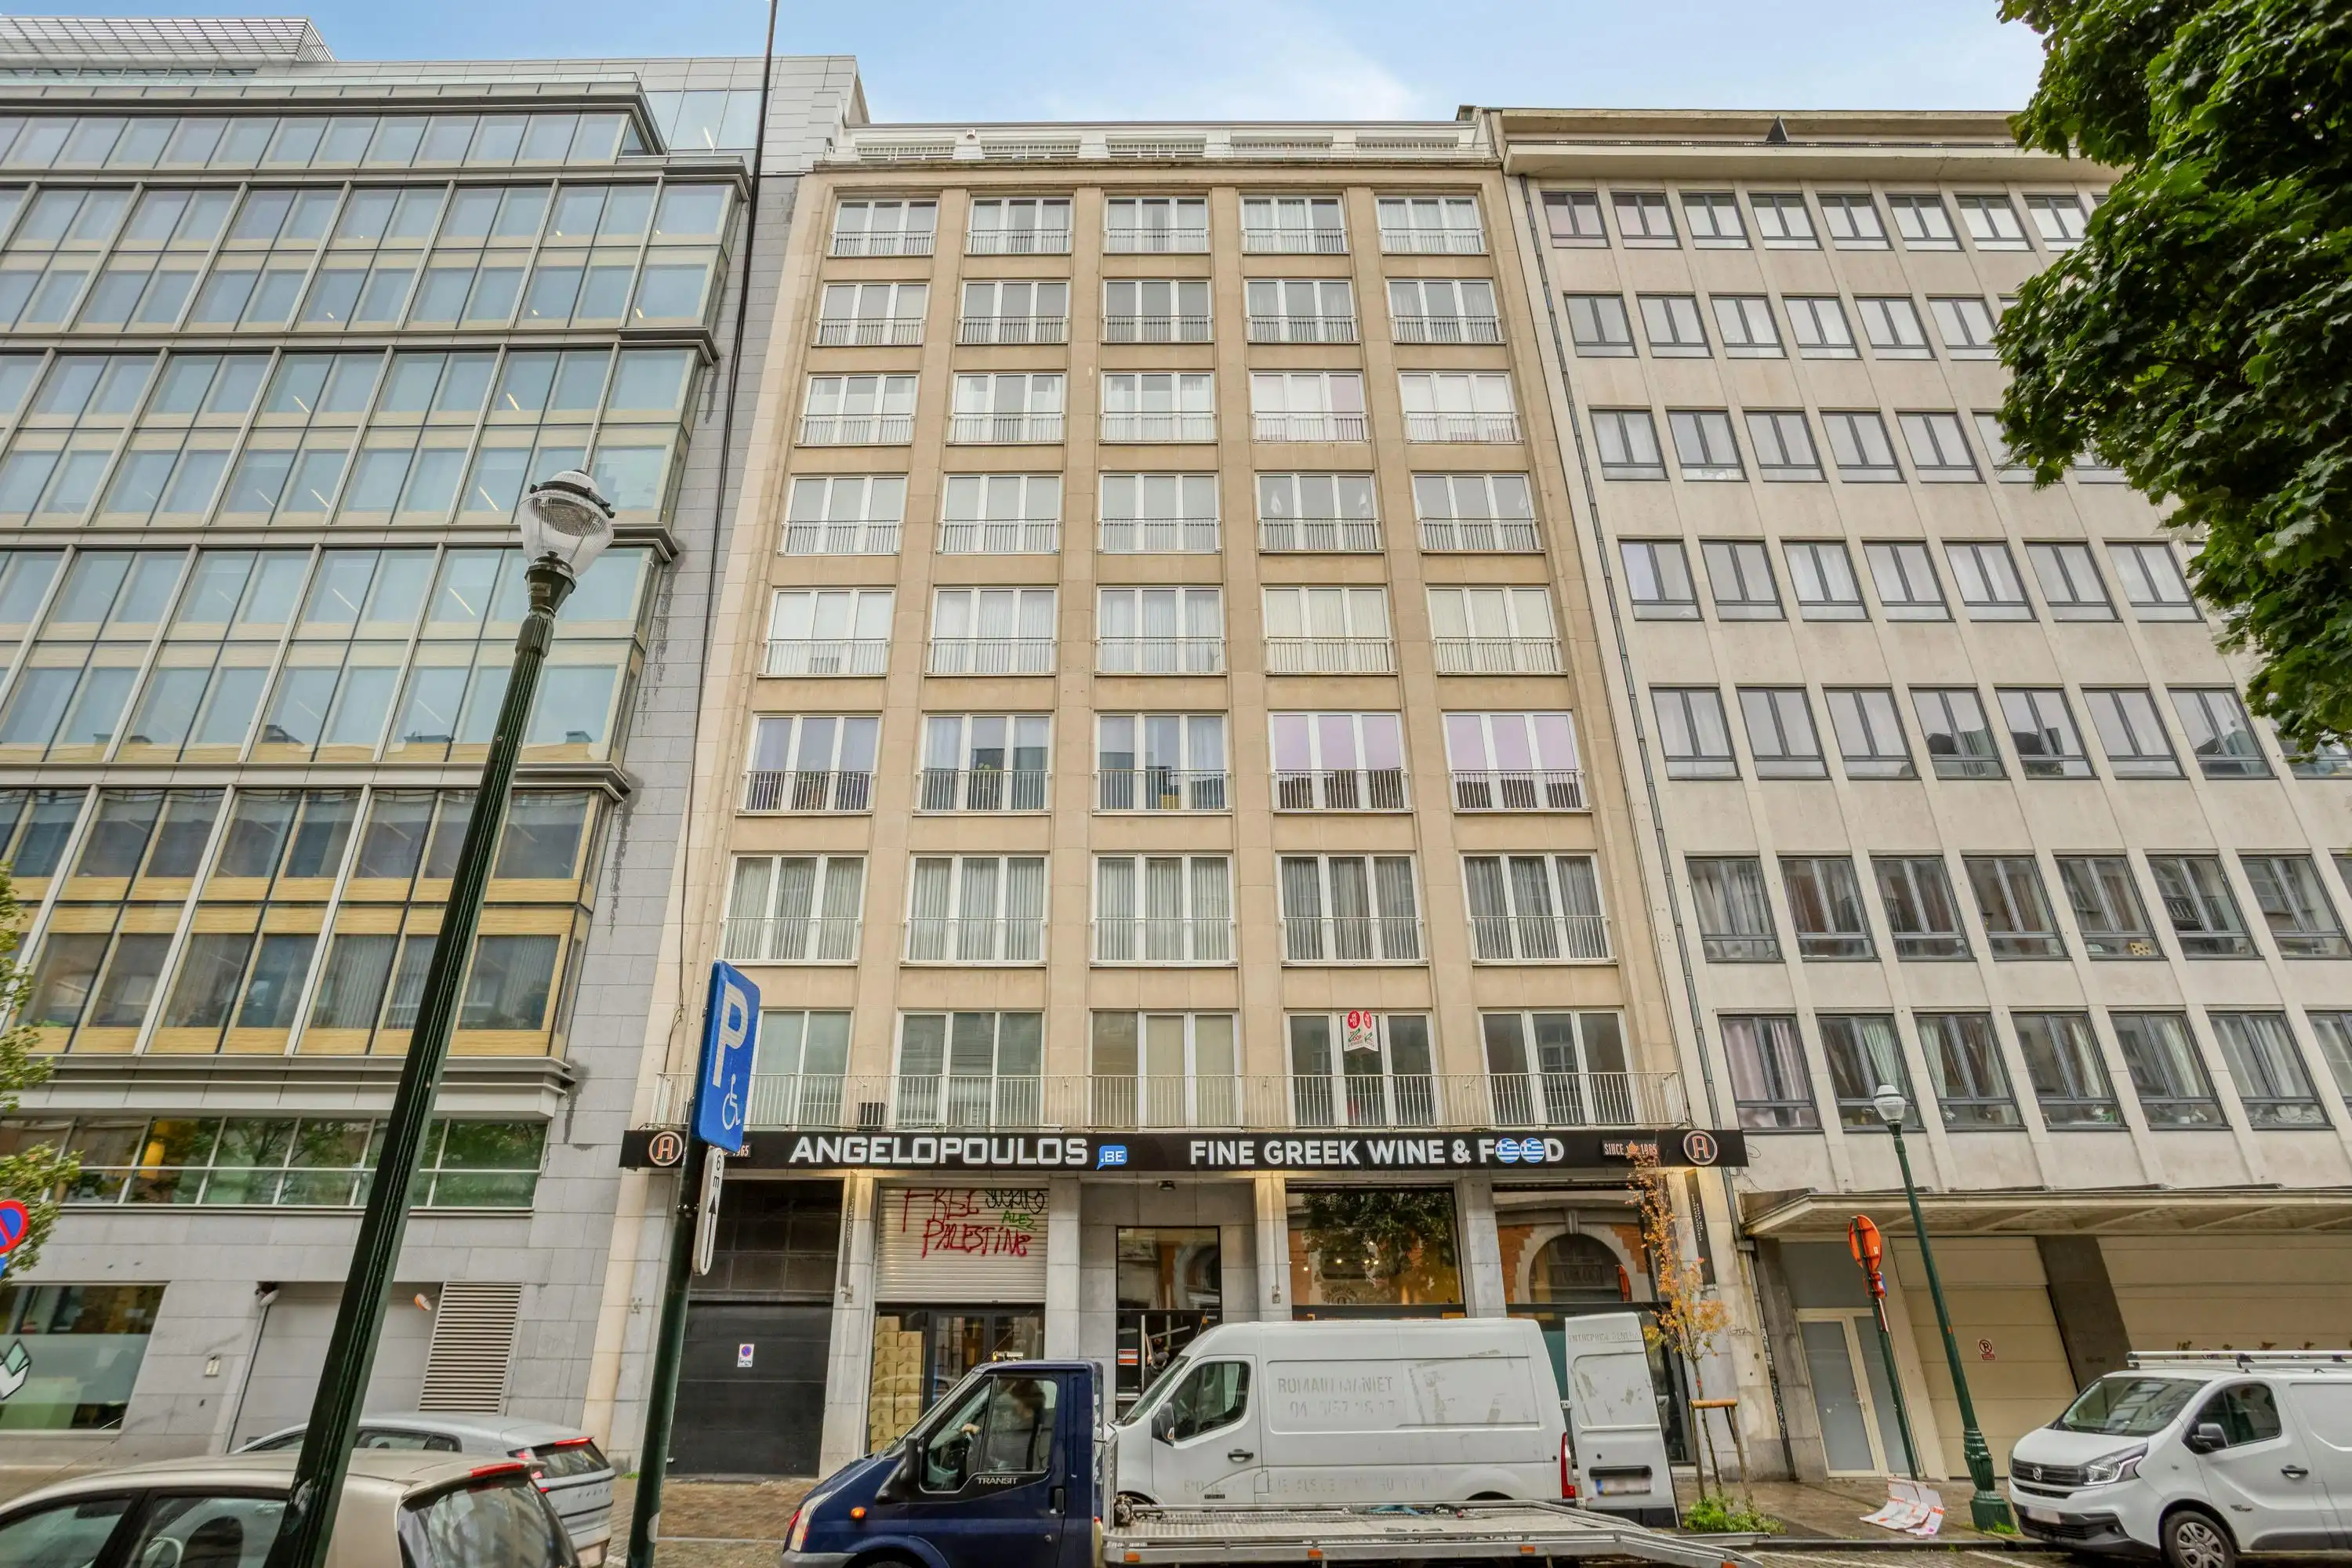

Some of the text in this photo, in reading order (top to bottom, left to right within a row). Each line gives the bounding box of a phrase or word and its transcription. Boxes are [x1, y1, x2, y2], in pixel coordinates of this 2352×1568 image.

[713, 980, 748, 1088] P
[788, 1136, 1088, 1164] ANGELOPOULOS
[1100, 1150, 1126, 1163] .BE
[1190, 1138, 1565, 1165] FINE GREEK WINE & FOOD
[1604, 1143, 1624, 1156] SINCE
[716, 1155, 721, 1171] 6
[713, 1175, 720, 1189] m
